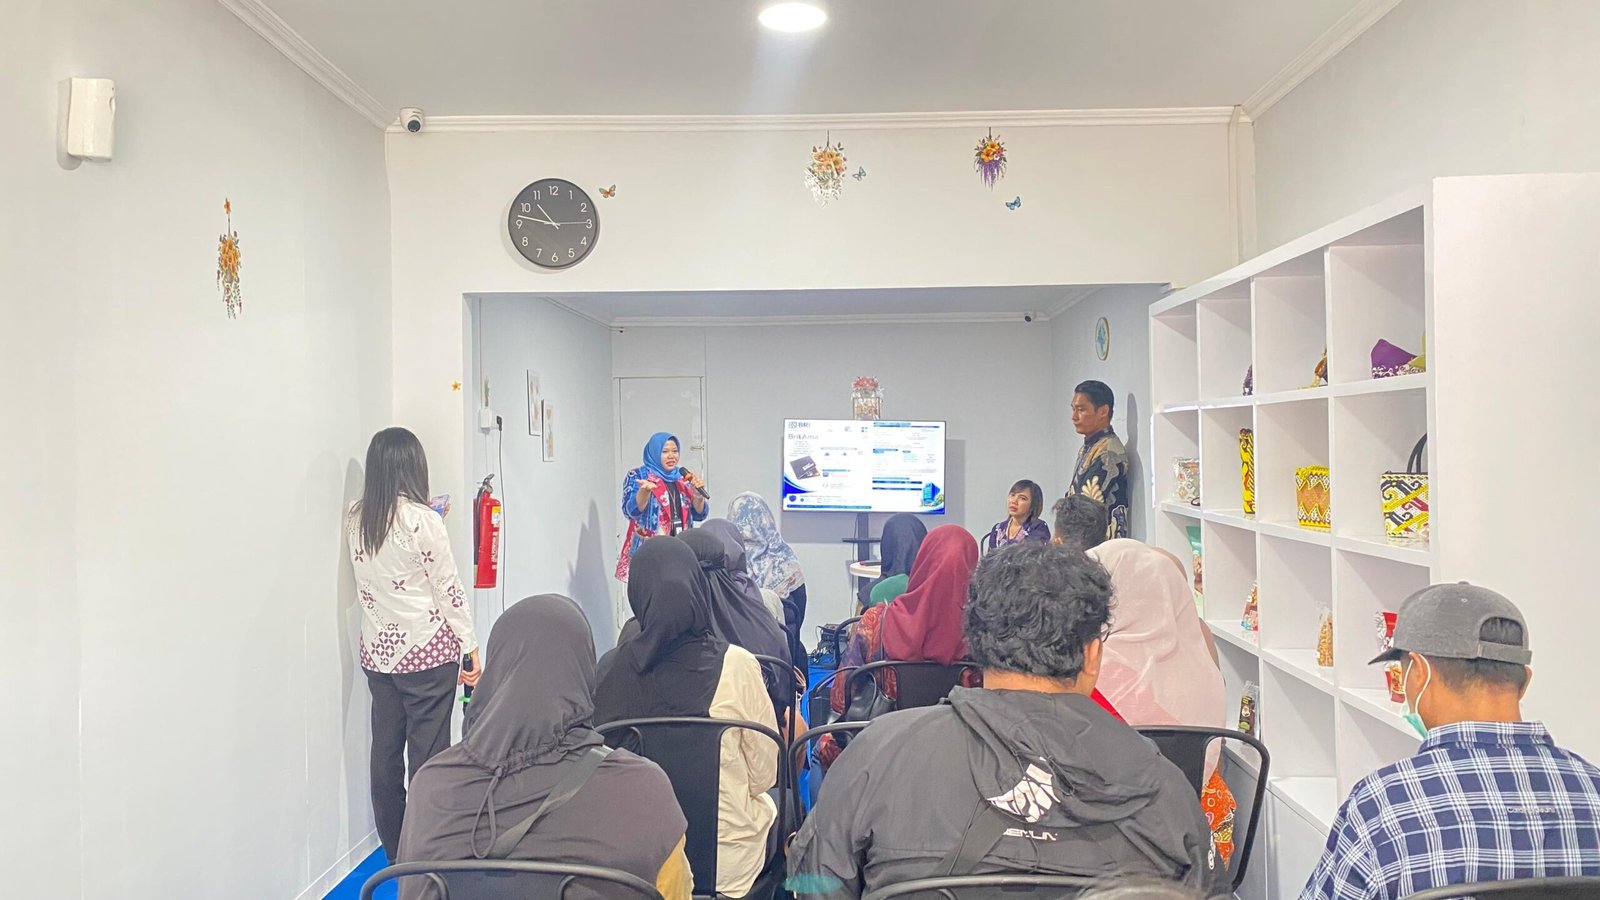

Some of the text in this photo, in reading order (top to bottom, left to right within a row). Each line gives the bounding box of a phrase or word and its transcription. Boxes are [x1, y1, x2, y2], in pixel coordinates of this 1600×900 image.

[533, 190, 541, 200] 11
[548, 185, 559, 196] 12
[520, 202, 531, 213] 10
[580, 202, 587, 213] 2
[515, 219, 523, 230] 9
[585, 219, 593, 229] 3
[521, 236, 529, 247] 8
[580, 236, 587, 246] 4
[536, 248, 543, 258] 7
[551, 252, 559, 262] 6
[567, 247, 575, 258] 5
